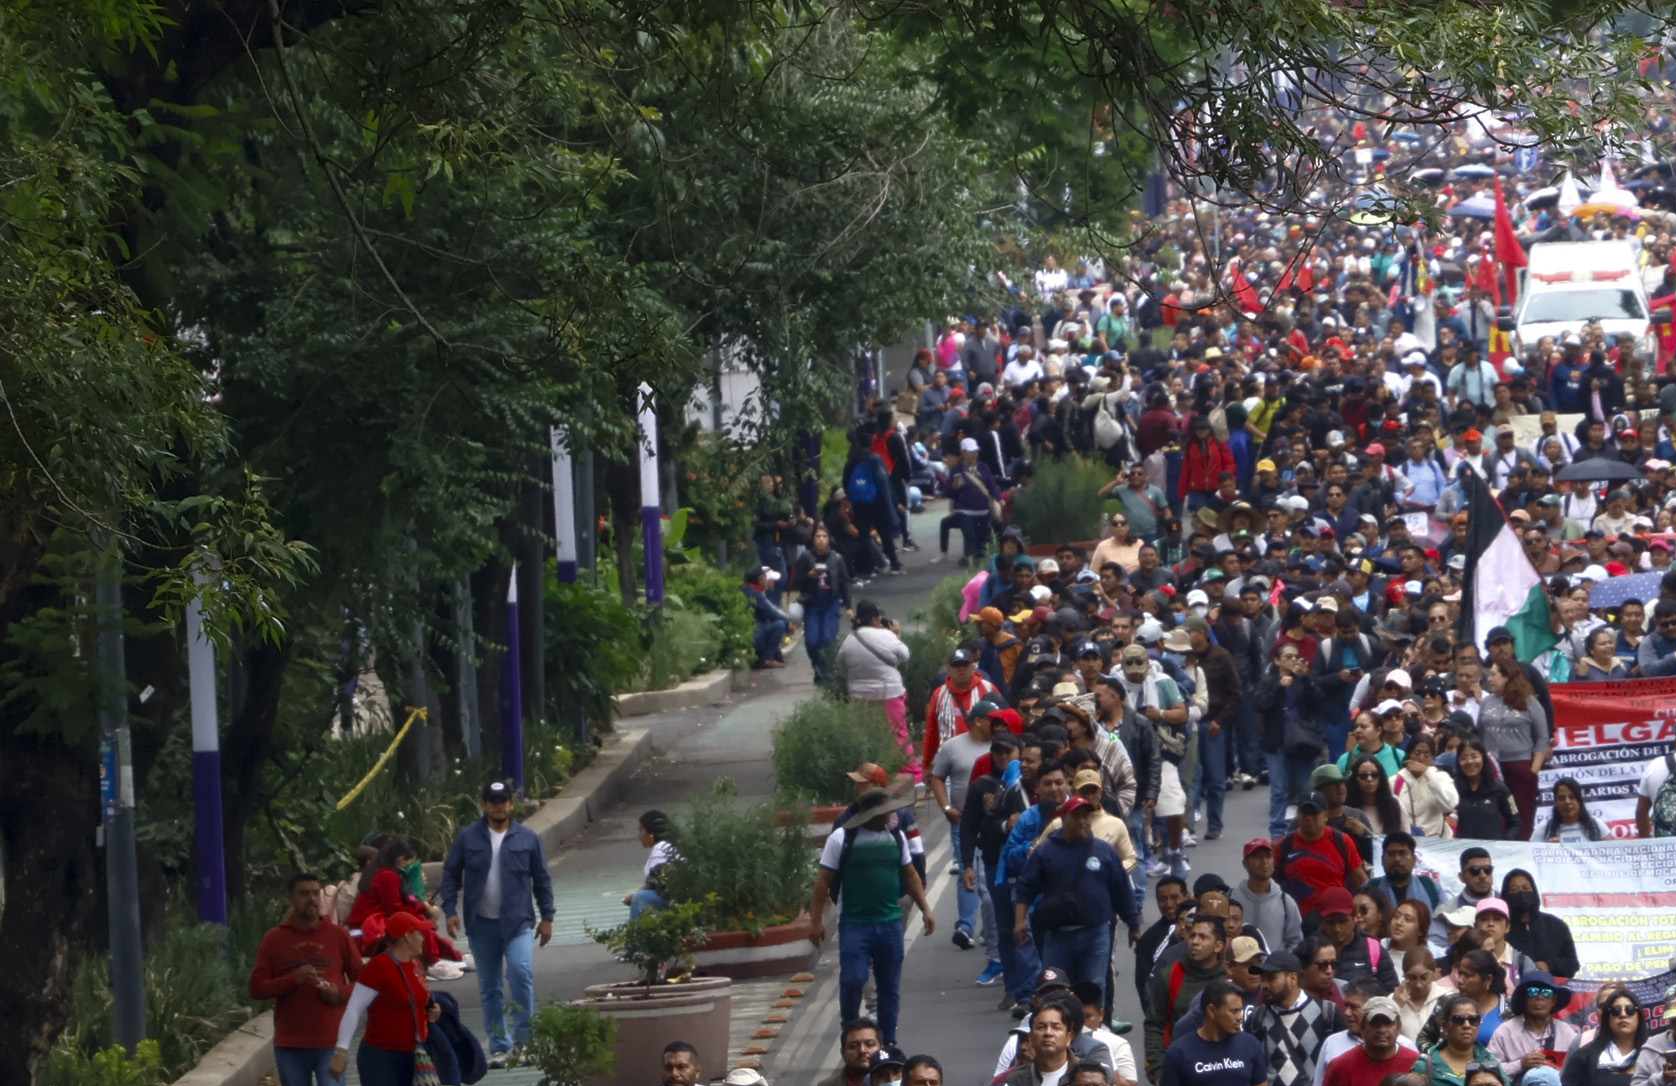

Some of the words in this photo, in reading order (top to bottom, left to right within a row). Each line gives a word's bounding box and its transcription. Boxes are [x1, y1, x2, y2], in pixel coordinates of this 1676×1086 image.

[1550, 747, 1640, 765] ABROGACIÓN
[1642, 746, 1662, 757] DE
[1195, 1061, 1223, 1073] Calvin
[1223, 1058, 1245, 1070] Klein
